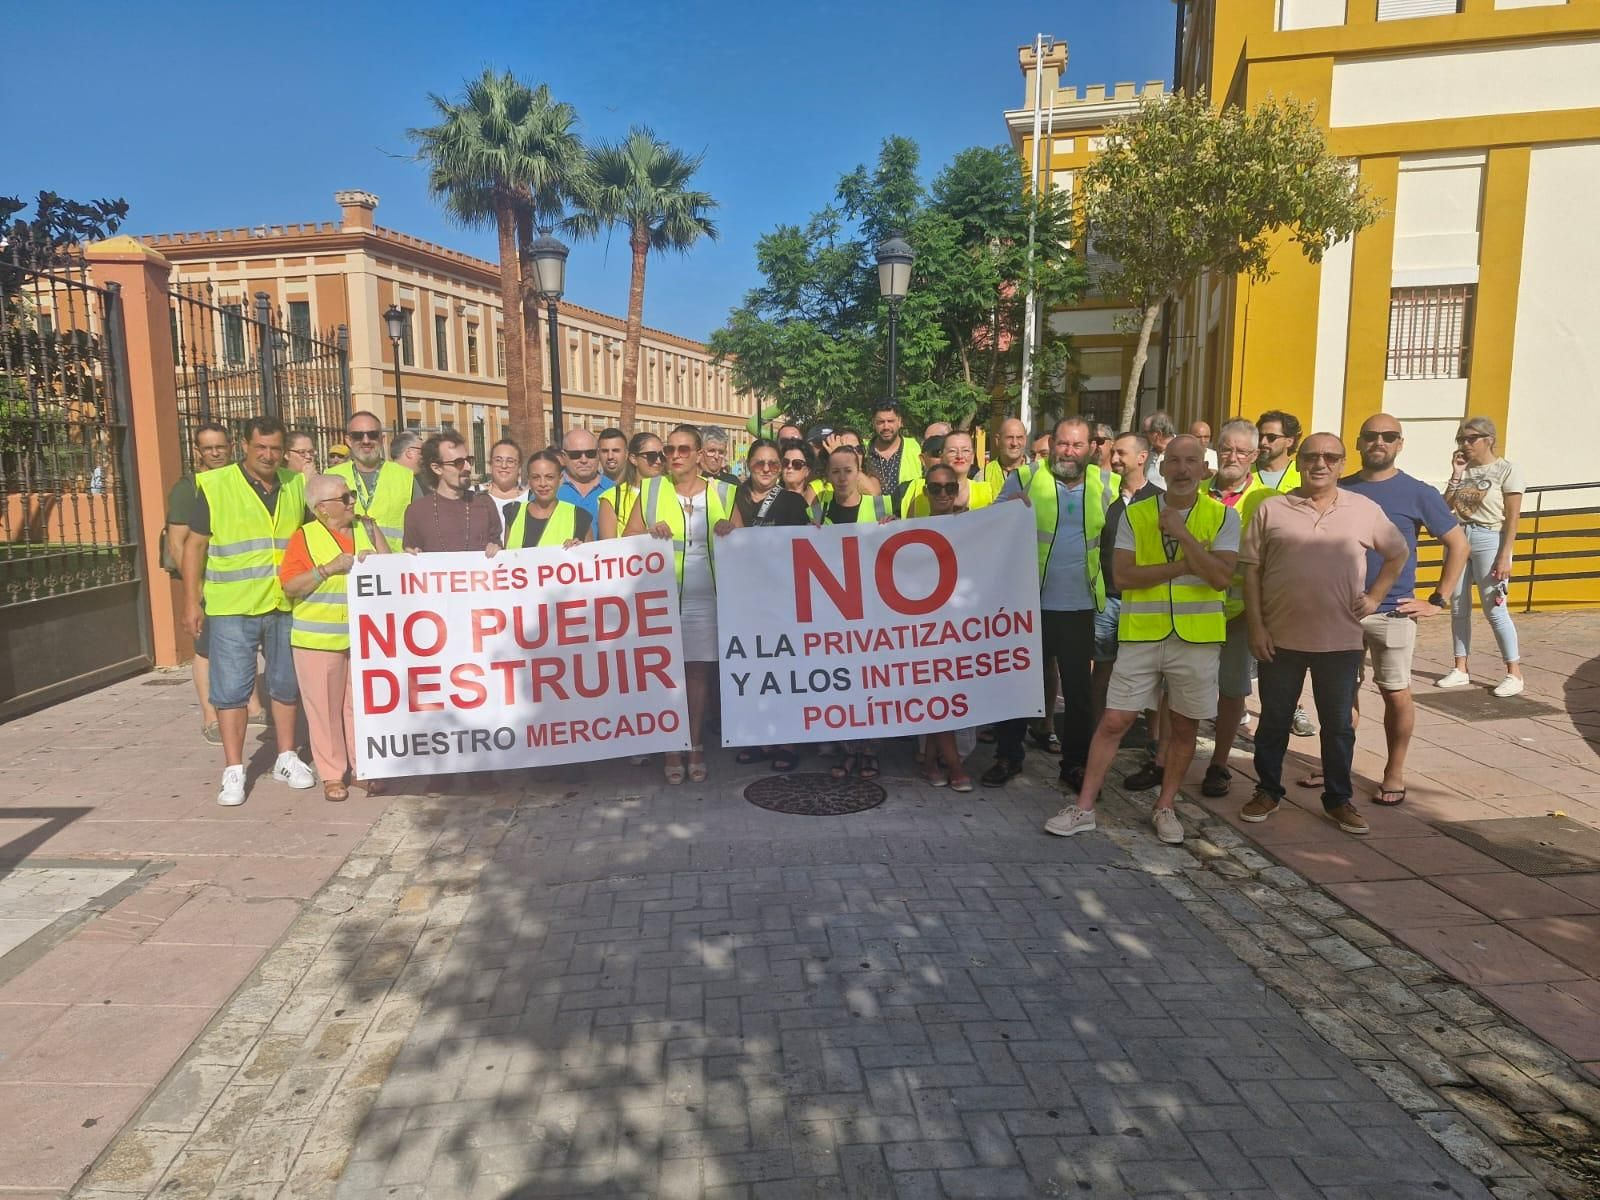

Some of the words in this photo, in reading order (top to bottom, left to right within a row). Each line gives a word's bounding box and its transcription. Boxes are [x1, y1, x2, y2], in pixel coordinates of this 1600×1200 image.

[356, 574, 392, 597] EL
[401, 564, 529, 594] INTERÉS
[538, 551, 665, 587] POLÍTICO
[792, 528, 958, 623] NO
[358, 609, 447, 660] NO
[471, 590, 673, 653] PUEDE
[725, 635, 747, 659] A
[756, 634, 796, 658] LA
[803, 607, 1033, 656] PRIVATIZACIÓN
[361, 645, 677, 715] DESTRUIR
[731, 672, 750, 696] Y
[759, 671, 782, 695] A
[790, 667, 851, 693] LOS
[861, 647, 1031, 689] INTERESES
[367, 726, 516, 759] NUESTRO
[526, 709, 680, 748] MERCADO
[803, 693, 969, 730] POLÍTICOS
